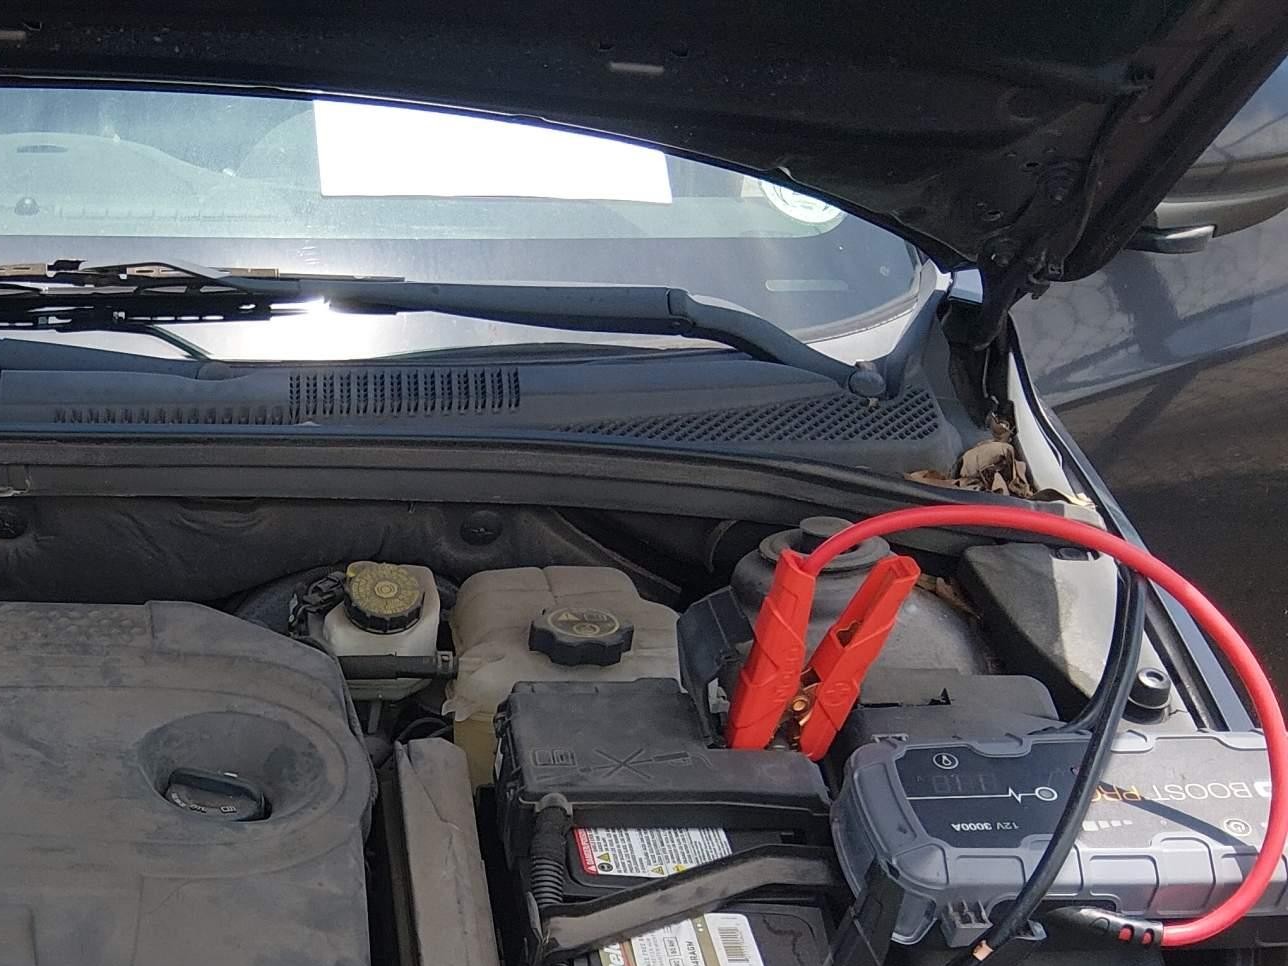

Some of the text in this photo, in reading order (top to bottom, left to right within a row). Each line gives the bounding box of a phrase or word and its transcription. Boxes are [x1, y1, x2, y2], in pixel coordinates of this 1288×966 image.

[1153, 782, 1253, 801] BOOST
[951, 822, 1019, 832] 12V 3000A
